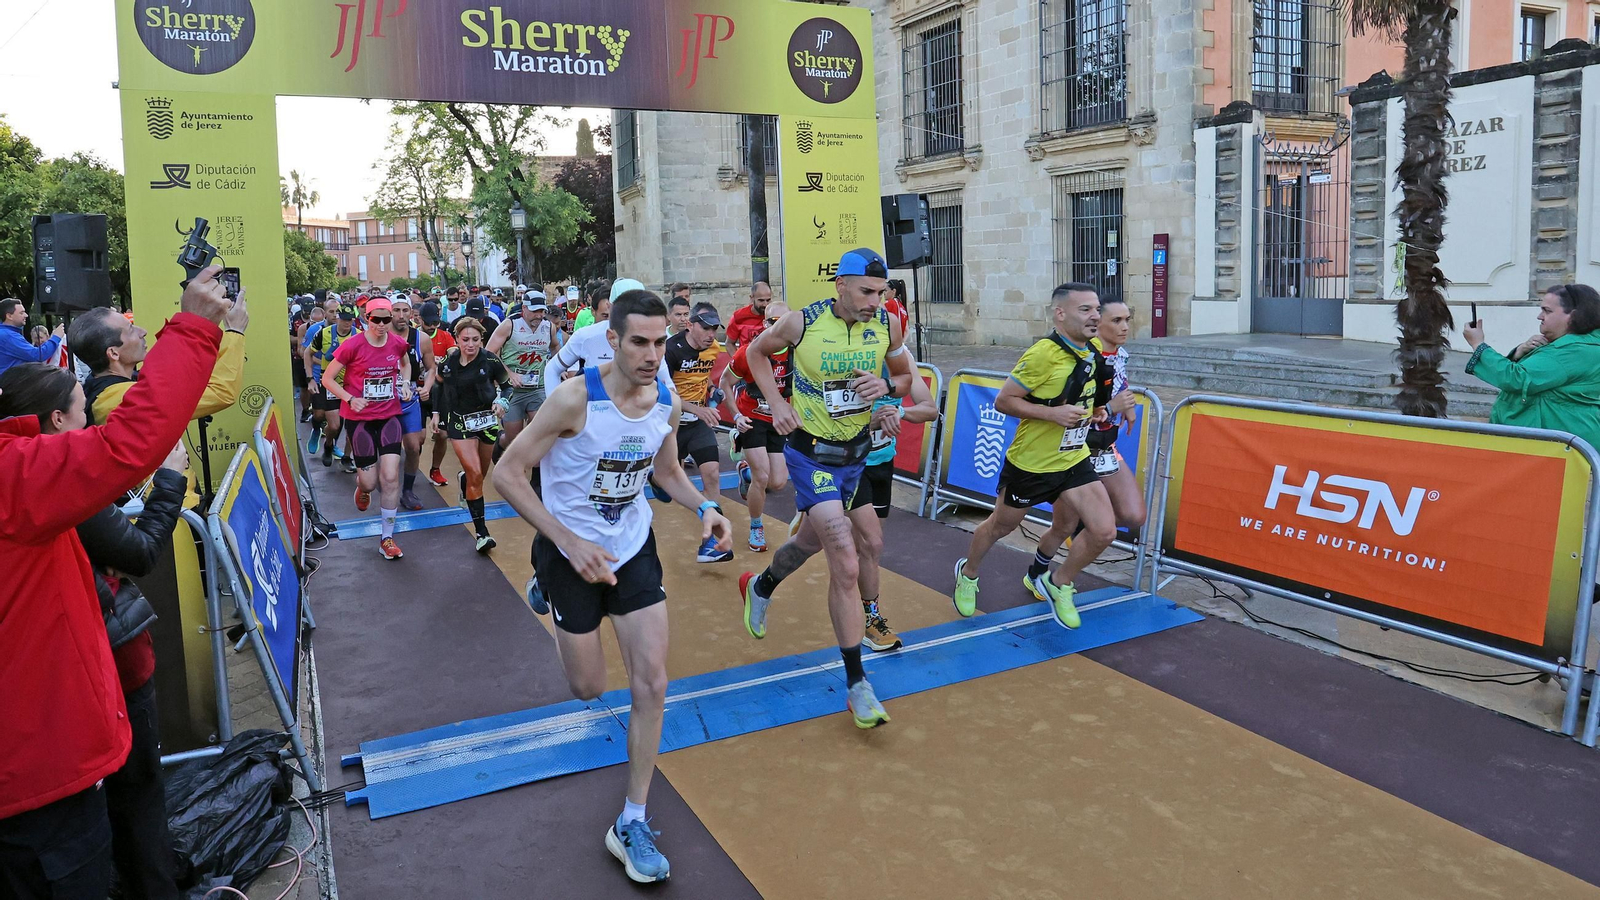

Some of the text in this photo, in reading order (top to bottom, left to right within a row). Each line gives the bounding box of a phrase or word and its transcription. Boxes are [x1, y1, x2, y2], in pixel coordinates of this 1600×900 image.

[145, 6, 245, 40] Sherry
[164, 29, 231, 42] Maratón
[460, 6, 631, 72] Sherry
[676, 13, 735, 89] JJP
[493, 50, 606, 76] Maratón
[793, 50, 856, 77] Sherry
[805, 67, 847, 79] Maratón
[180, 111, 254, 121] Ayuntamiento
[180, 121, 222, 131] de Jerez
[1446, 117, 1505, 138] AZAR
[817, 131, 863, 140] Ayuntamiento
[827, 139, 843, 147] Jerez
[195, 164, 256, 176] Diputación
[1446, 155, 1487, 173] REZ
[196, 178, 246, 189] de Cádiz
[826, 172, 865, 183] Diputación
[826, 184, 858, 193] de Cádiz
[216, 216, 243, 224] JEREZ
[817, 263, 840, 276] HS
[820, 350, 876, 361] CANILLAS DE
[820, 360, 877, 373] ALBAIDA
[241, 384, 272, 404] VALDESPIN
[373, 385, 387, 393] 117
[842, 389, 857, 403] 67
[473, 417, 488, 427] 230
[1074, 427, 1086, 439] 13
[614, 472, 639, 489] 131
[1240, 516, 1447, 572] WE ARE NUTRITION!
